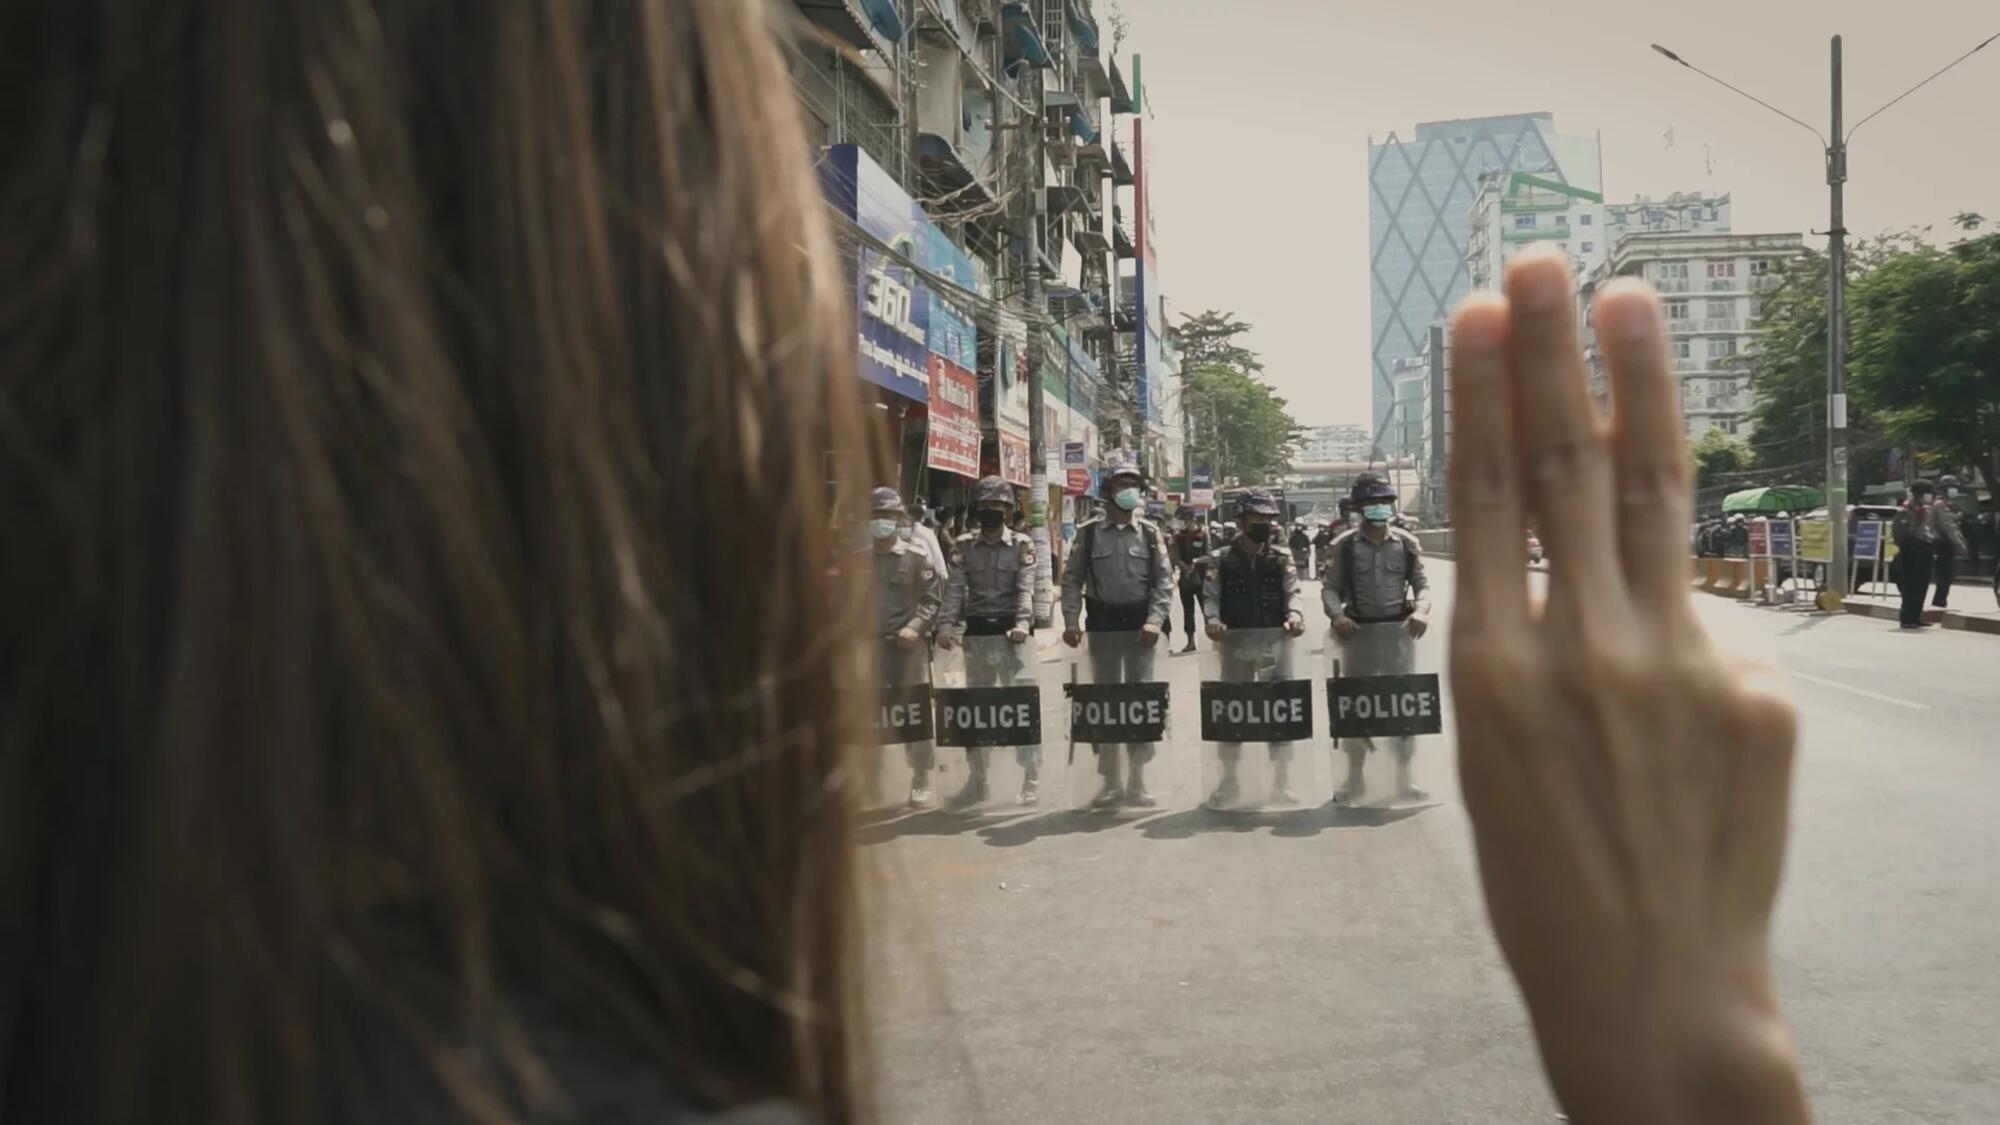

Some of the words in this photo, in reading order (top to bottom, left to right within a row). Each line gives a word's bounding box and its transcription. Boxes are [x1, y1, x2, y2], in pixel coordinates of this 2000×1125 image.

[864, 268, 911, 333] 360
[943, 704, 1031, 729] POLICE
[1072, 700, 1160, 725] POLICE
[1211, 698, 1303, 724] POLICE
[1338, 692, 1432, 719] POLICE
